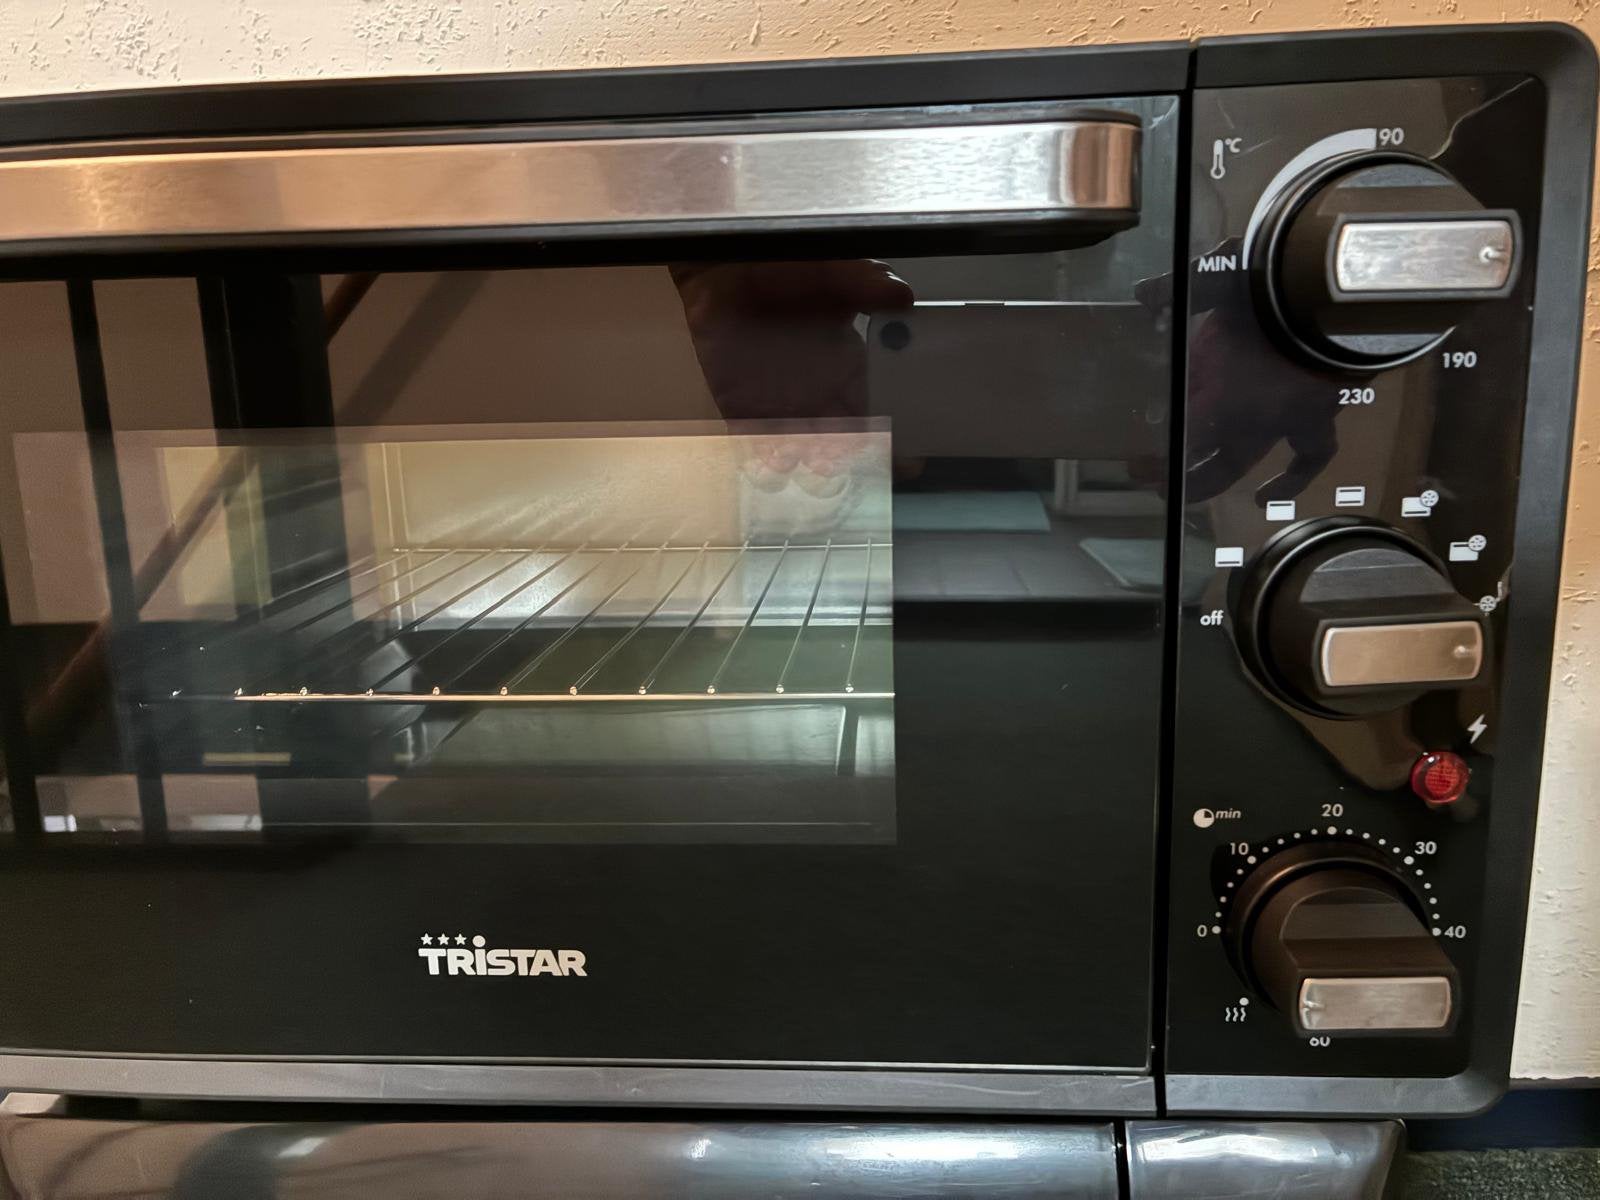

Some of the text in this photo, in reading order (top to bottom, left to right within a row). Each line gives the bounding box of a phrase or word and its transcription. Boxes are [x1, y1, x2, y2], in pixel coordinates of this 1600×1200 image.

[1379, 127, 1404, 145] 90
[1197, 255, 1237, 272] MIN
[1442, 352, 1477, 368] 190
[1338, 388, 1375, 405] 230
[1200, 610, 1224, 626] off
[1215, 808, 1242, 819] min
[1321, 803, 1344, 818] 20
[1229, 842, 1249, 856] 10
[1414, 841, 1437, 855] 30
[1197, 925, 1207, 938] 0
[1444, 925, 1467, 939] 40
